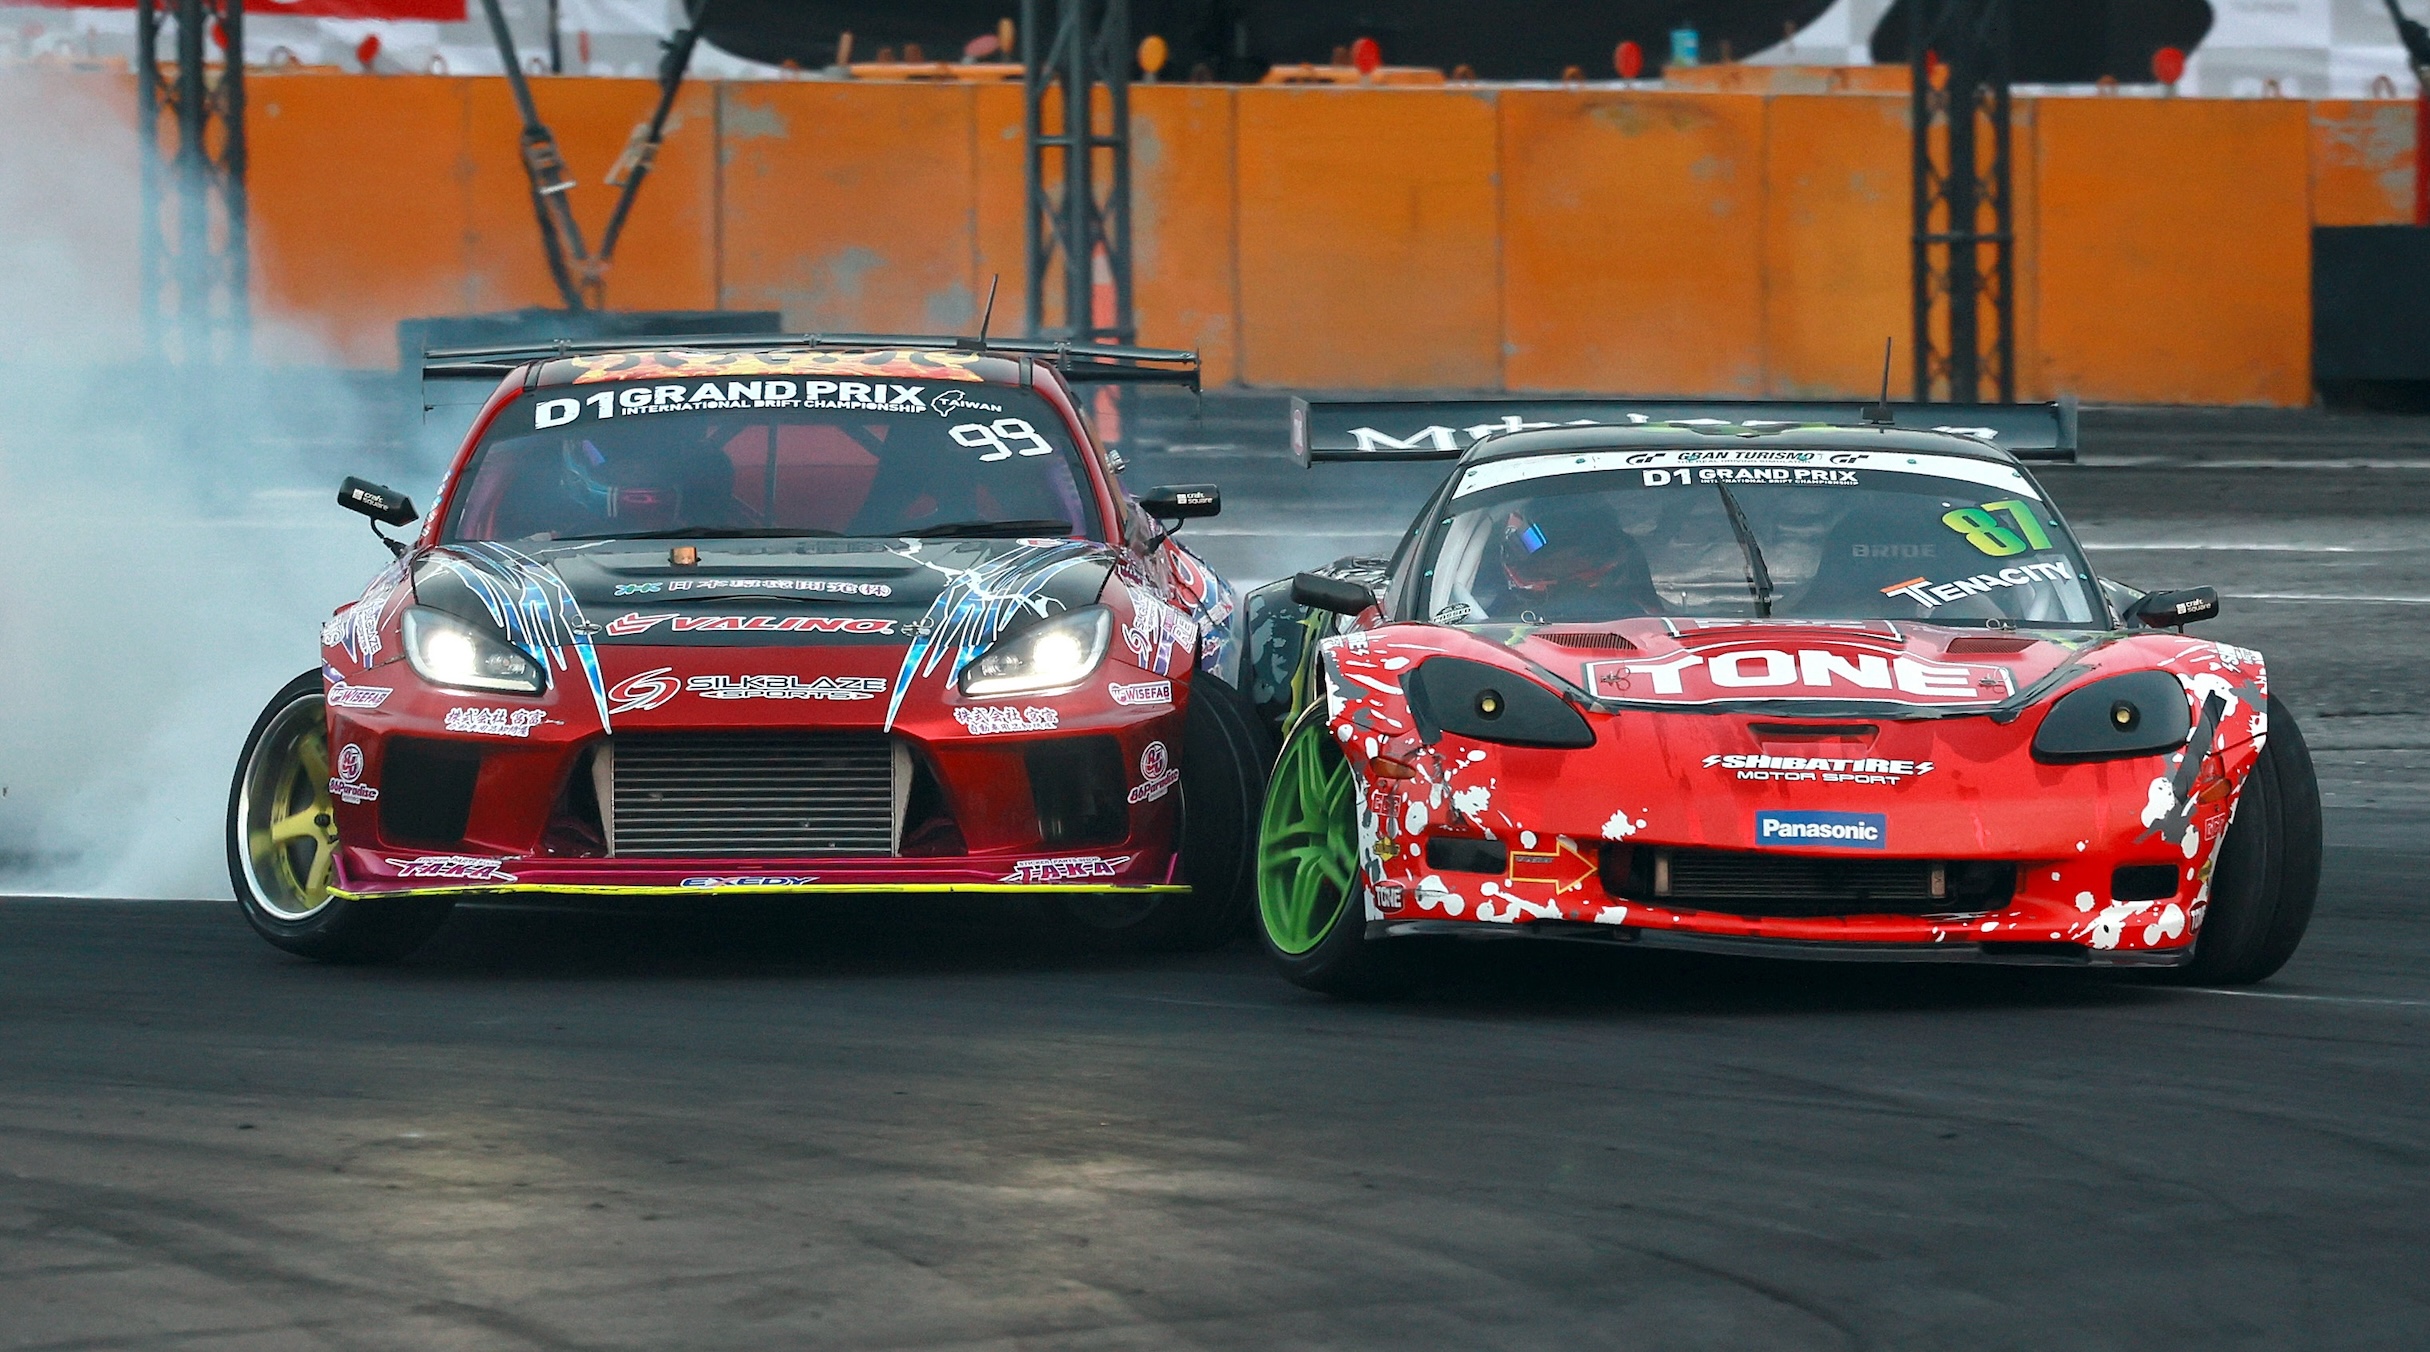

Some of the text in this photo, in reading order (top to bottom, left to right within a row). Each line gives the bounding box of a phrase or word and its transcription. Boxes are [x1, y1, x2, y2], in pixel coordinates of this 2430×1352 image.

[535, 380, 926, 430] D1 GRAND PRIX
[621, 399, 927, 416] INTERNATIONAL DRIFT CHAMPIONSHIP
[939, 397, 1002, 413] TAIWAN
[948, 417, 1053, 462] 99
[1677, 451, 1815, 461] GRAN TURISMO
[1642, 468, 1859, 487] D1 GRAND PRIX
[1941, 500, 2053, 557] 87
[1852, 544, 1937, 558] BRIDE
[1880, 562, 2073, 609] TENACITY
[672, 615, 892, 634] VALINO
[1626, 650, 1978, 697] TONE
[686, 674, 888, 693] SILKBLAZE
[1126, 686, 1170, 700] WISEFAB
[717, 690, 851, 700] SPORTS
[1721, 754, 1914, 776] SHIBATIRE
[1736, 771, 1901, 786] MOTOR SPORT
[1762, 818, 1878, 842] Panasonic
[680, 876, 820, 889] EXEDY
